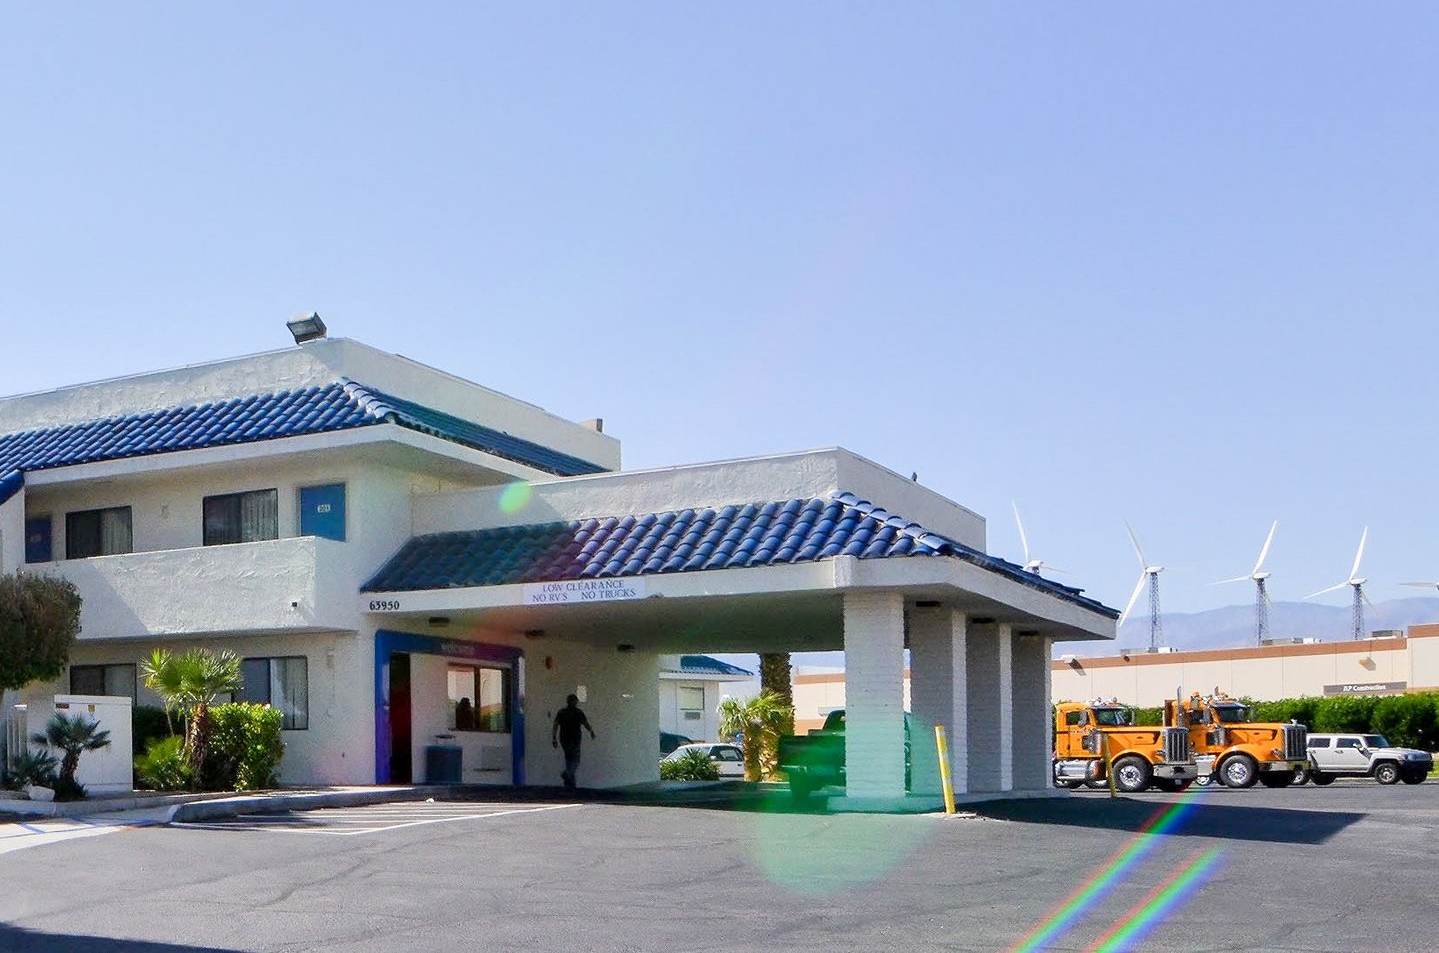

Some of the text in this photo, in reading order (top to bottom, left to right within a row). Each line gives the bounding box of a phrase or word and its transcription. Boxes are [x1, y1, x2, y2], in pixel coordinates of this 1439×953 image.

[543, 580, 624, 593] LOW CLEARANCE
[532, 593, 547, 602] NO
[581, 590, 596, 600] NO
[600, 588, 637, 599] TRUCKS
[369, 600, 400, 610] 63950
